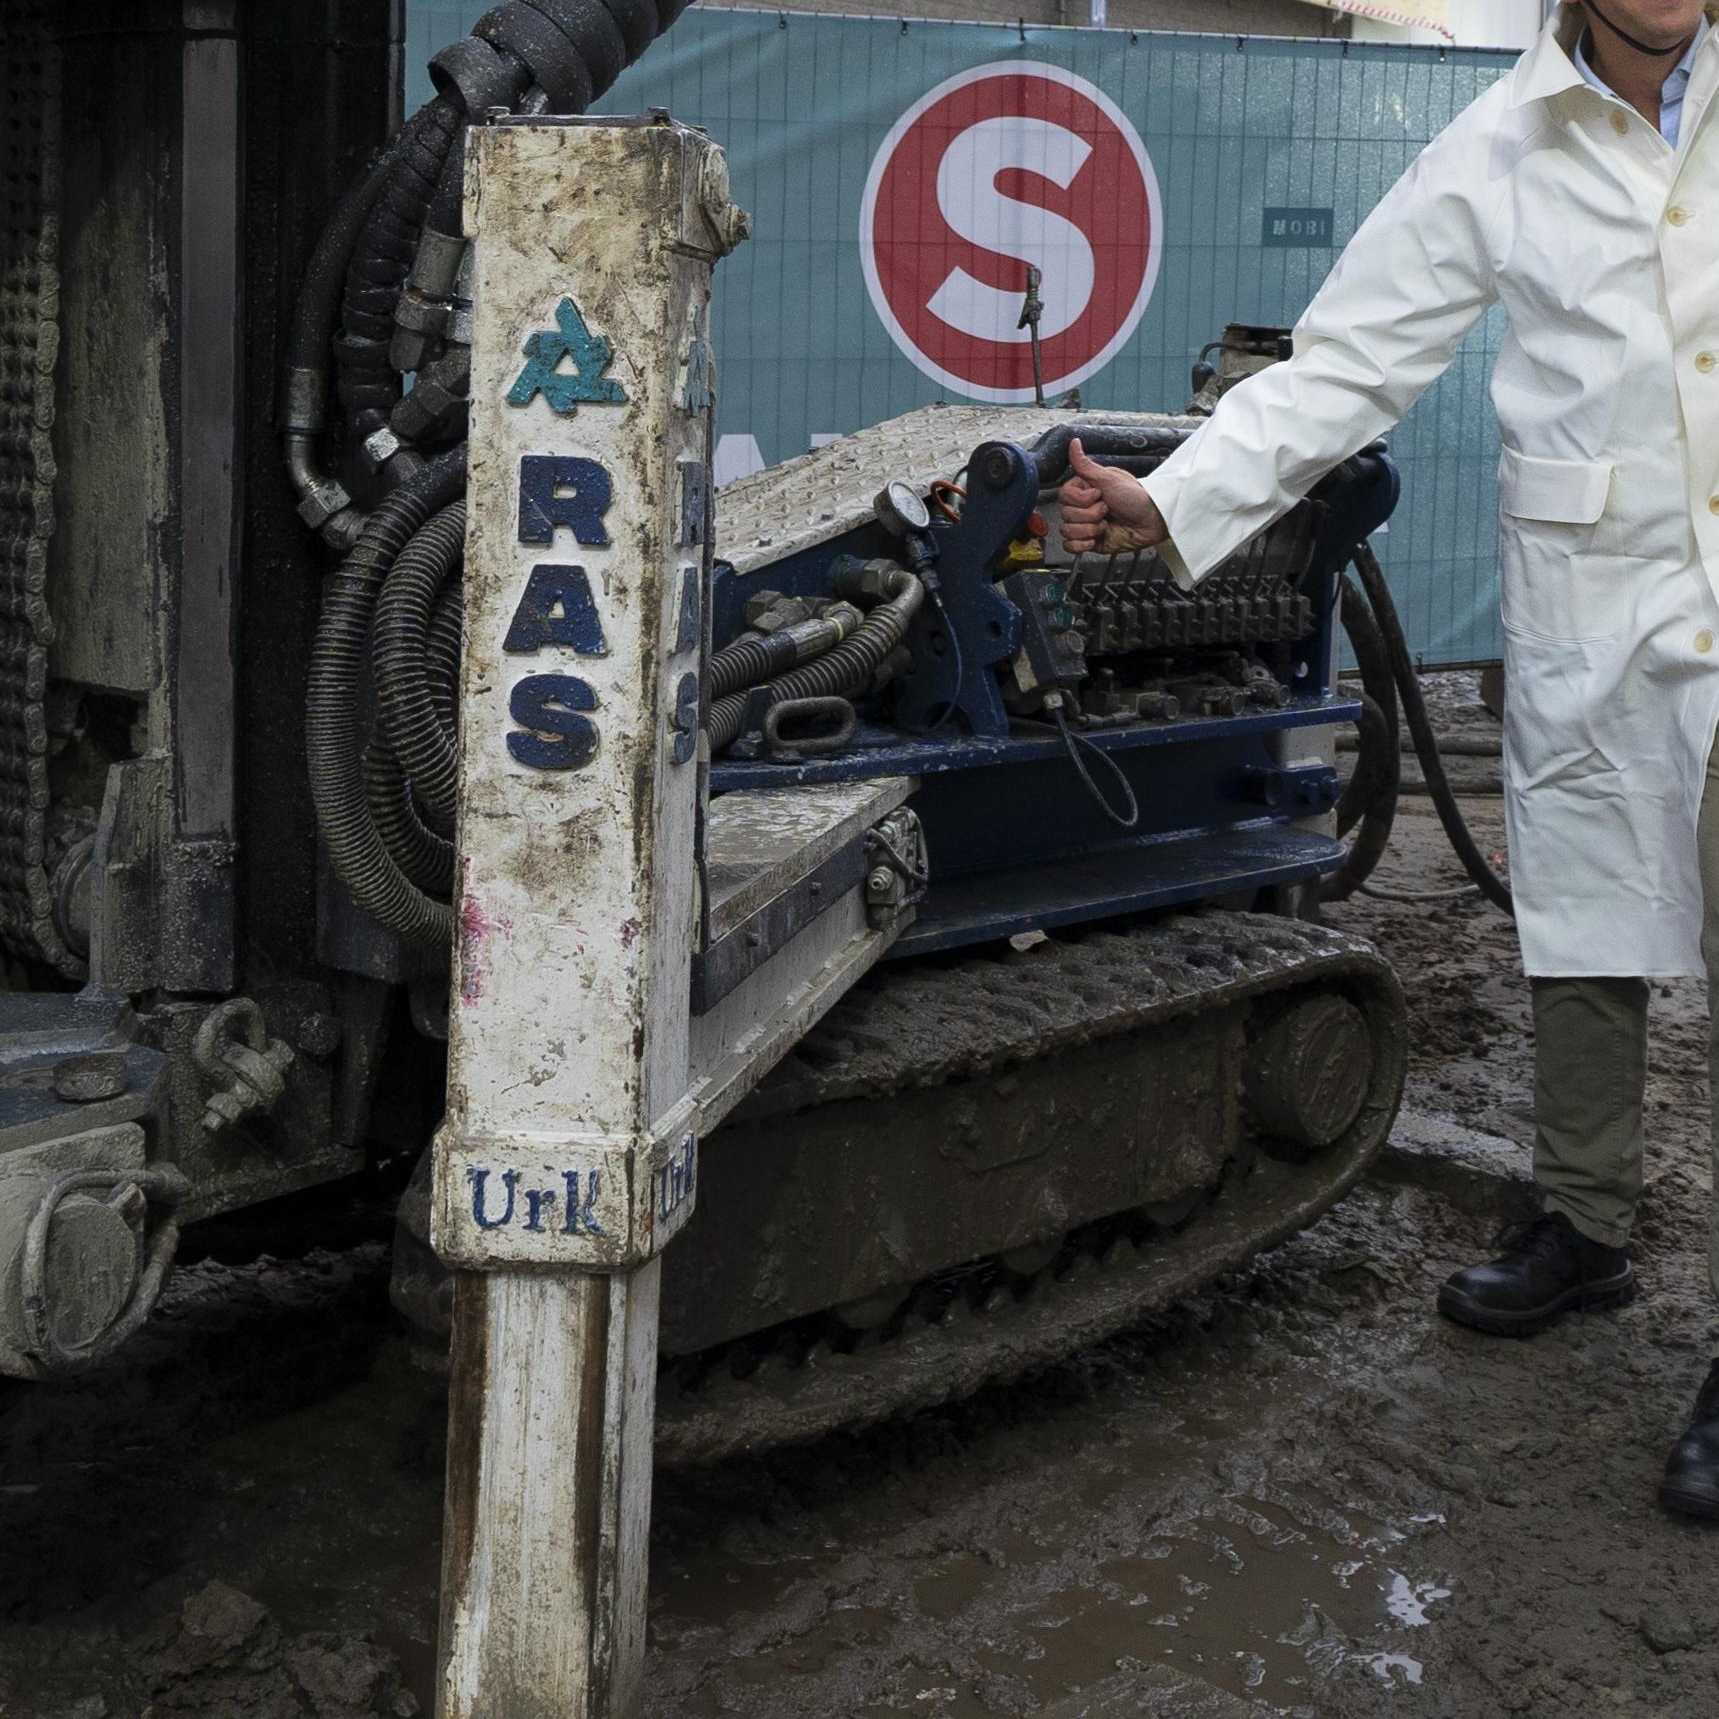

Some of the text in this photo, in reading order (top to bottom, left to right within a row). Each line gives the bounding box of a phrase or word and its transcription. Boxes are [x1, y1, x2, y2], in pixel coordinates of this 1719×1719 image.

[925, 115, 1094, 344] S
[1273, 219, 1325, 236] MOBI
[467, 1164, 606, 1235] Urk
